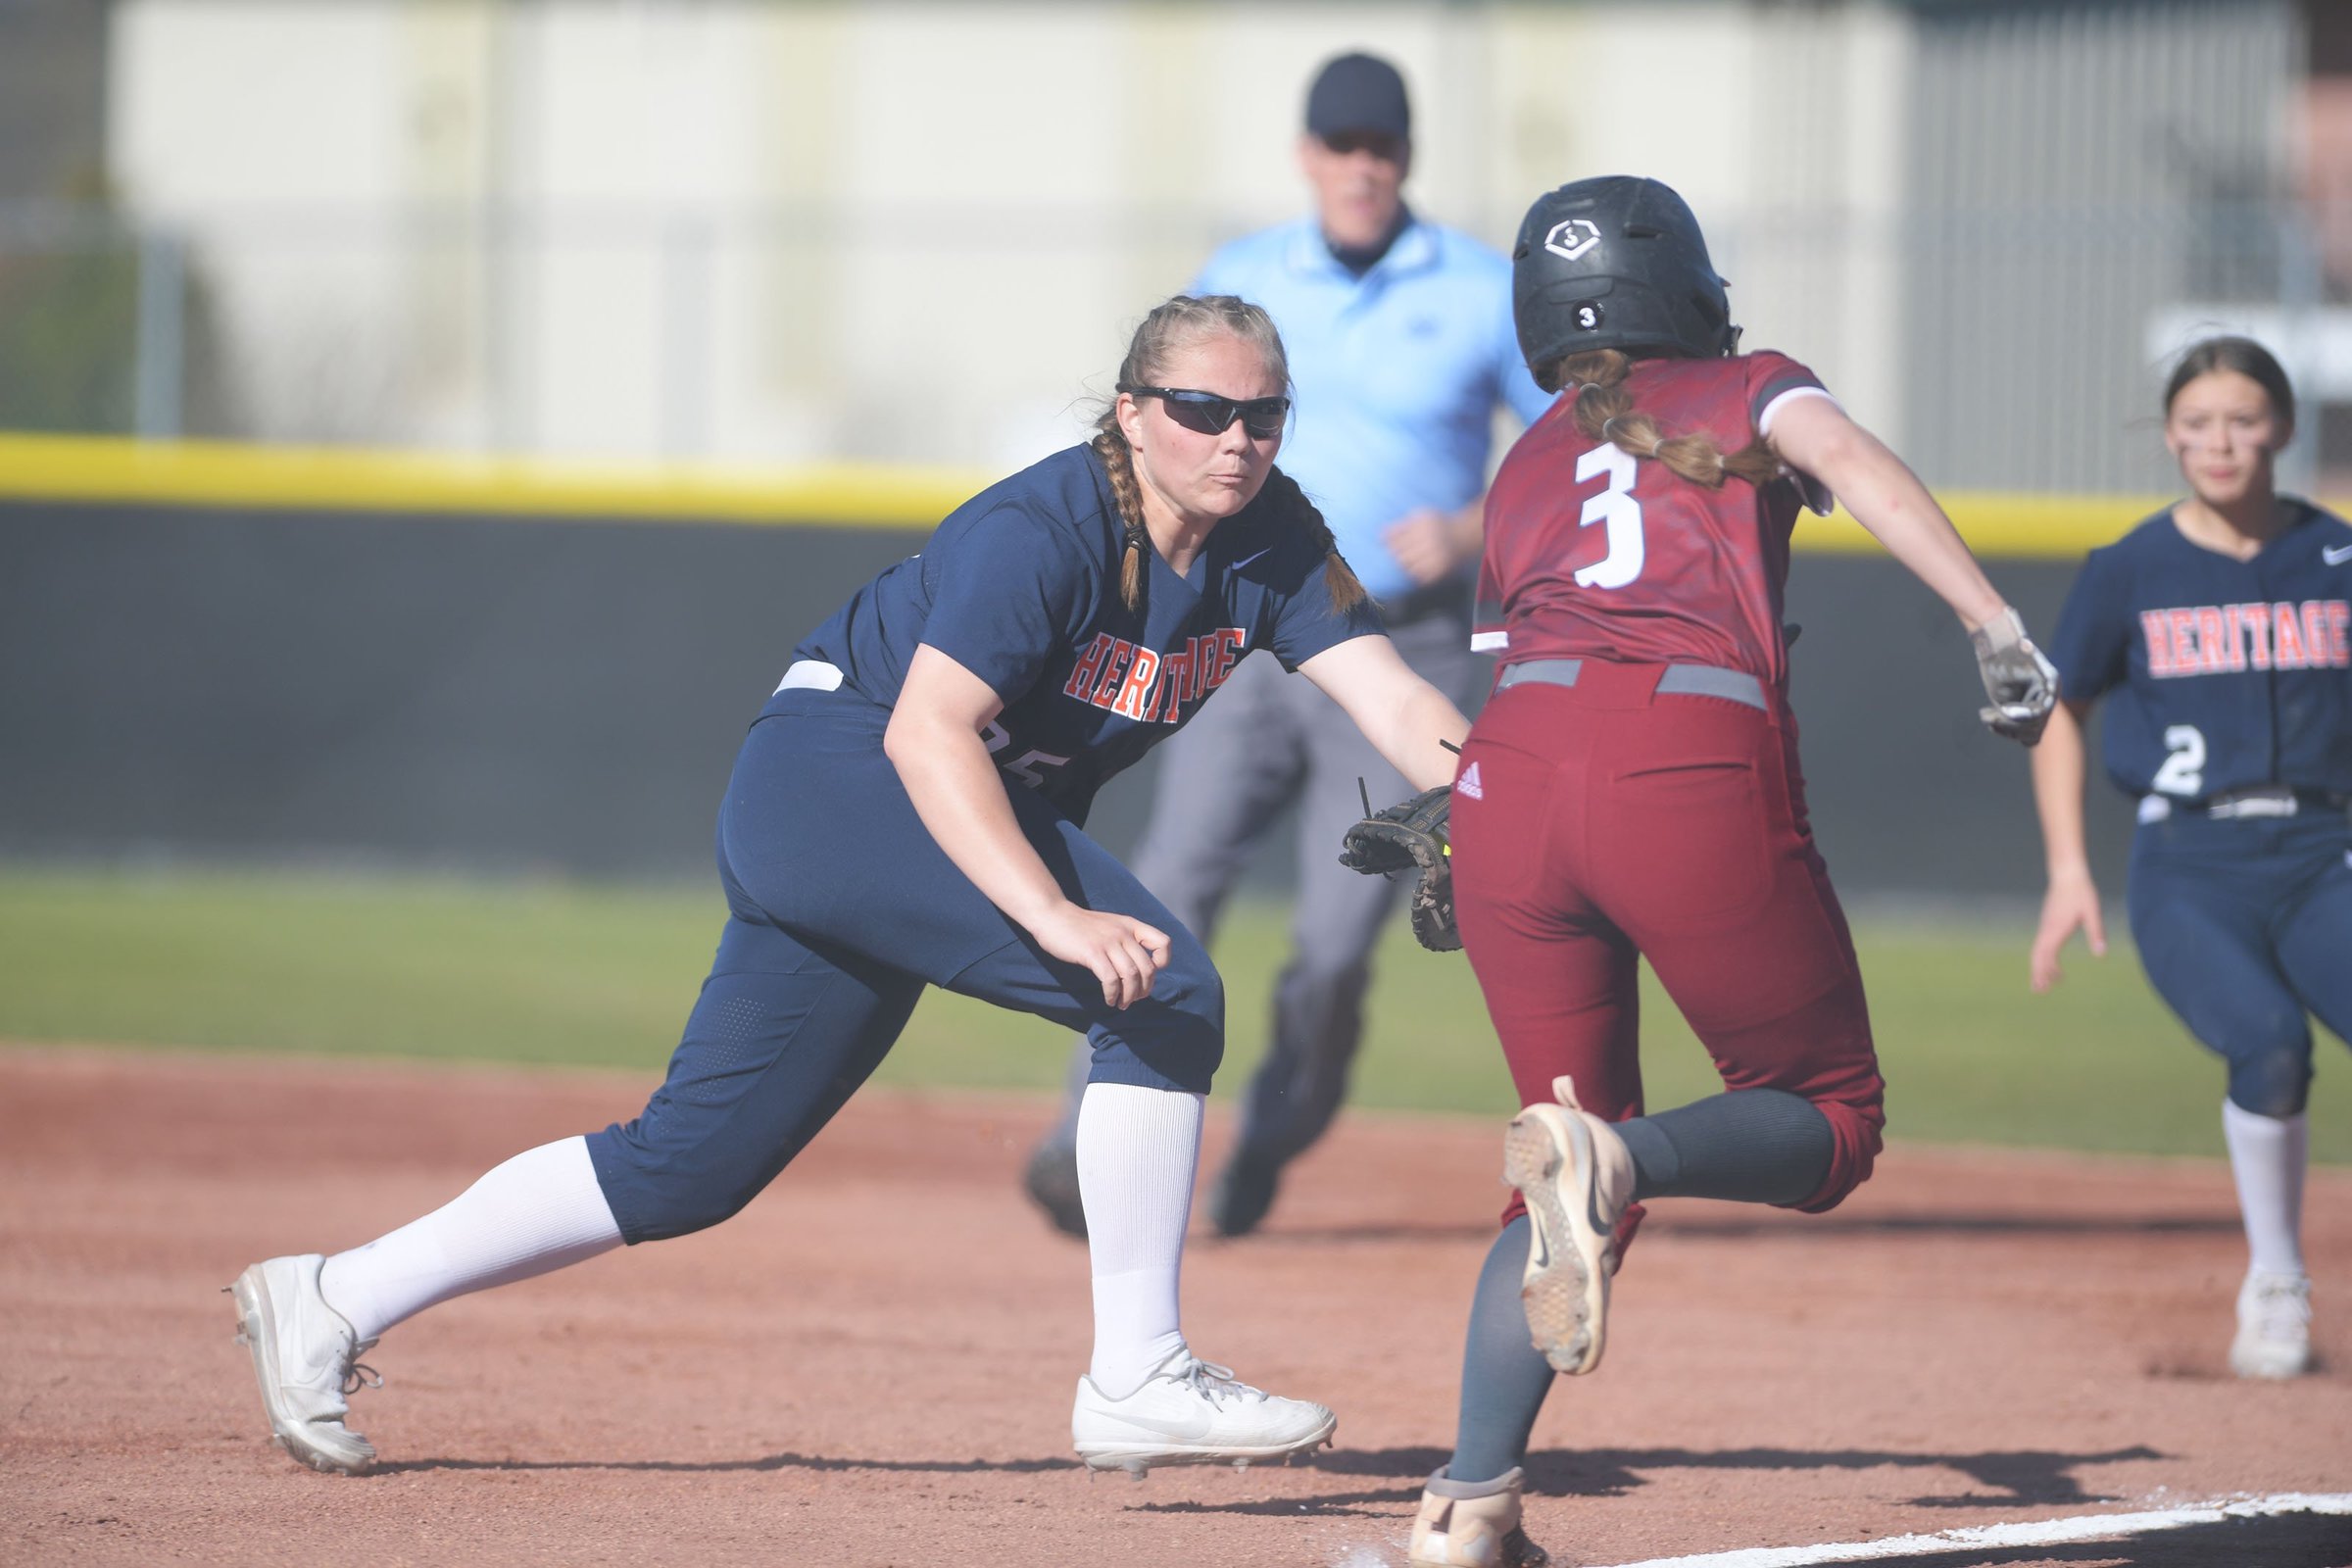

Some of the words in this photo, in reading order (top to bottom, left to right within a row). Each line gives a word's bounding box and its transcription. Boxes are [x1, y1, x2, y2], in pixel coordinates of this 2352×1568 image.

[1579, 307, 1596, 328] 3
[1574, 441, 1644, 589] 3
[2139, 600, 2350, 679] HERITAGE
[2153, 724, 2206, 797] 2
